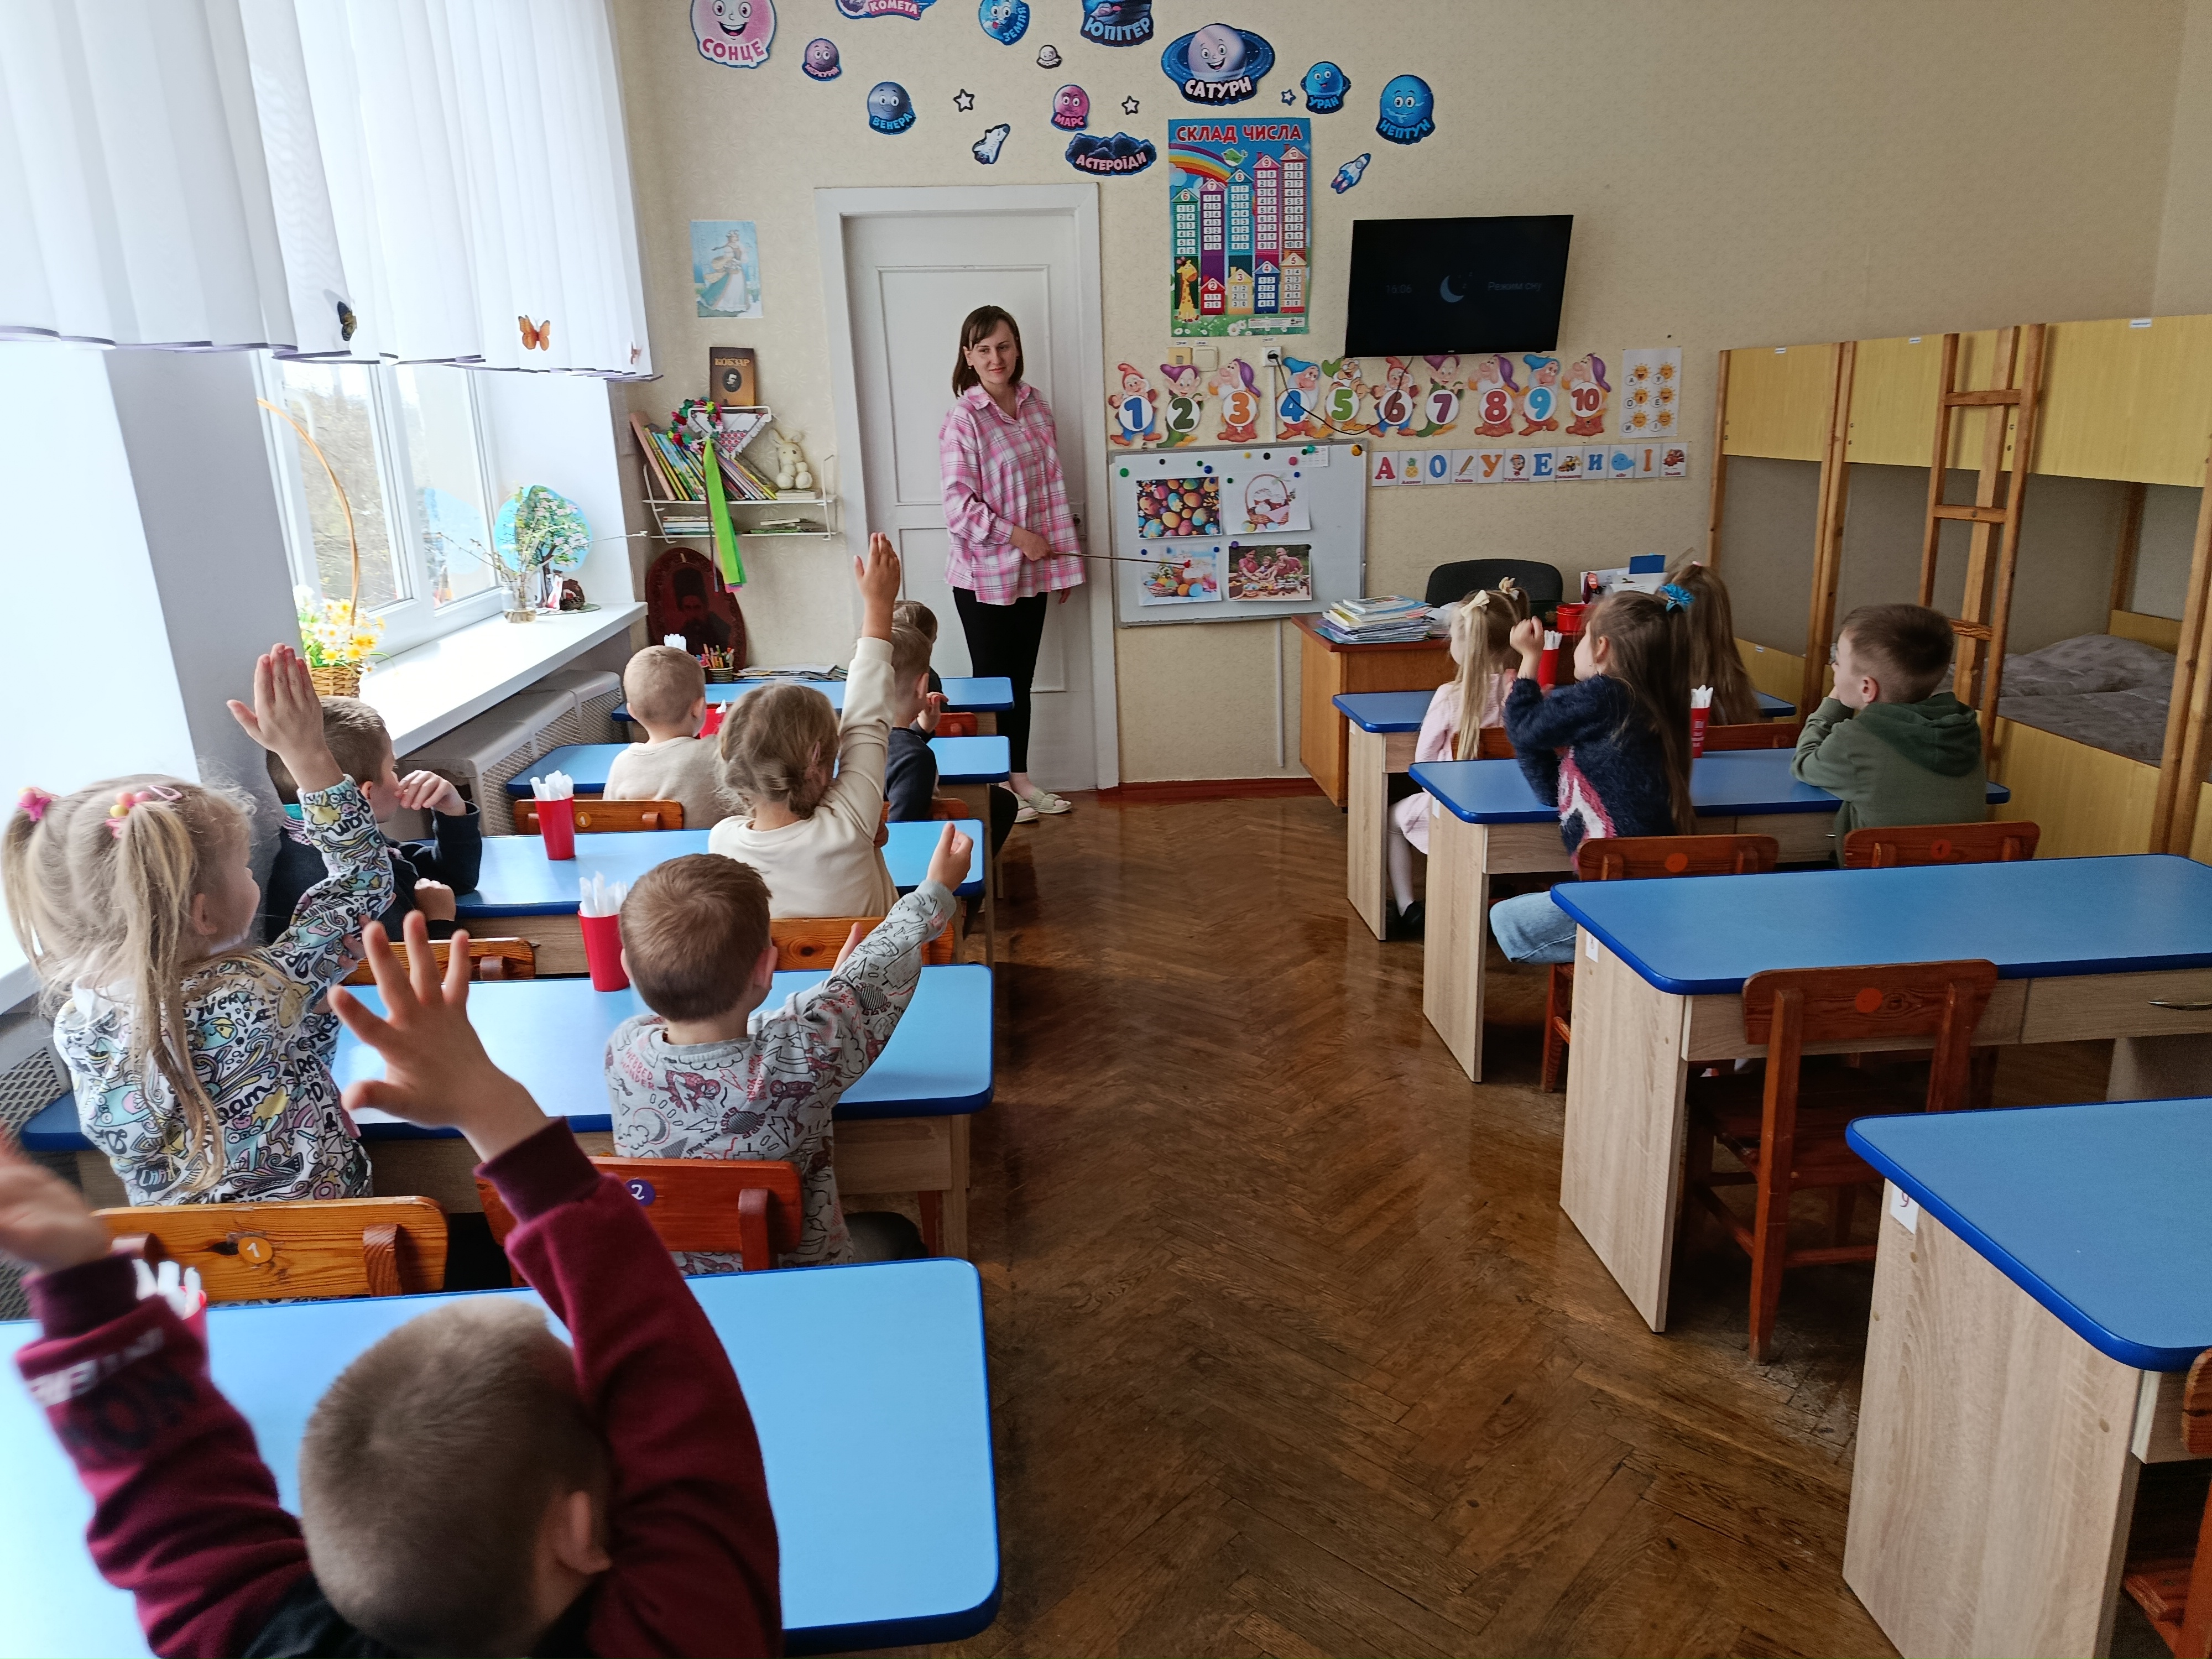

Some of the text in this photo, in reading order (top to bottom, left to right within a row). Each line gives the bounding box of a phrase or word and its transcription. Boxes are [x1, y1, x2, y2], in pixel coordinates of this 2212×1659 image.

[870, 0, 917, 14] КОМЕТА
[1003, 7, 1027, 41] ЗЕМЛЯ
[1084, 17, 1150, 40] ЮПІТЕР
[702, 38, 765, 62] СОНЦЕ
[1185, 76, 1252, 98] САТУРН
[1308, 96, 1339, 108] УРАН
[872, 113, 912, 129] ВЕНЕРА
[1054, 114, 1084, 127] МАРС
[1379, 118, 1431, 139] НЕПТУН
[1176, 124, 1302, 143] СКЛАД ЧИСЛА
[1076, 152, 1147, 170] АСТЕРОЇДИ
[1264, 159, 1270, 167] 9
[1228, 391, 1250, 424] 3
[1280, 390, 1305, 422] 4
[1331, 389, 1353, 421] 5
[1383, 392, 1406, 423] 6
[1433, 393, 1453, 423] 7
[1485, 390, 1506, 422] 8
[1528, 388, 1551, 419] 9
[1572, 388, 1599, 411] 10
[1124, 398, 1144, 429] 1
[1172, 397, 1195, 430] 2
[1375, 457, 1395, 479] А
[1430, 455, 1447, 478] О
[1480, 454, 1503, 477] У
[1533, 453, 1553, 476] Е
[1588, 453, 1603, 470] И
[1643, 448, 1653, 472] І
[625, 1048, 654, 1081] WEBBED
[747, 1078, 757, 1102] YORK
[631, 1184, 645, 1200] 2
[247, 1242, 260, 1258] 1
